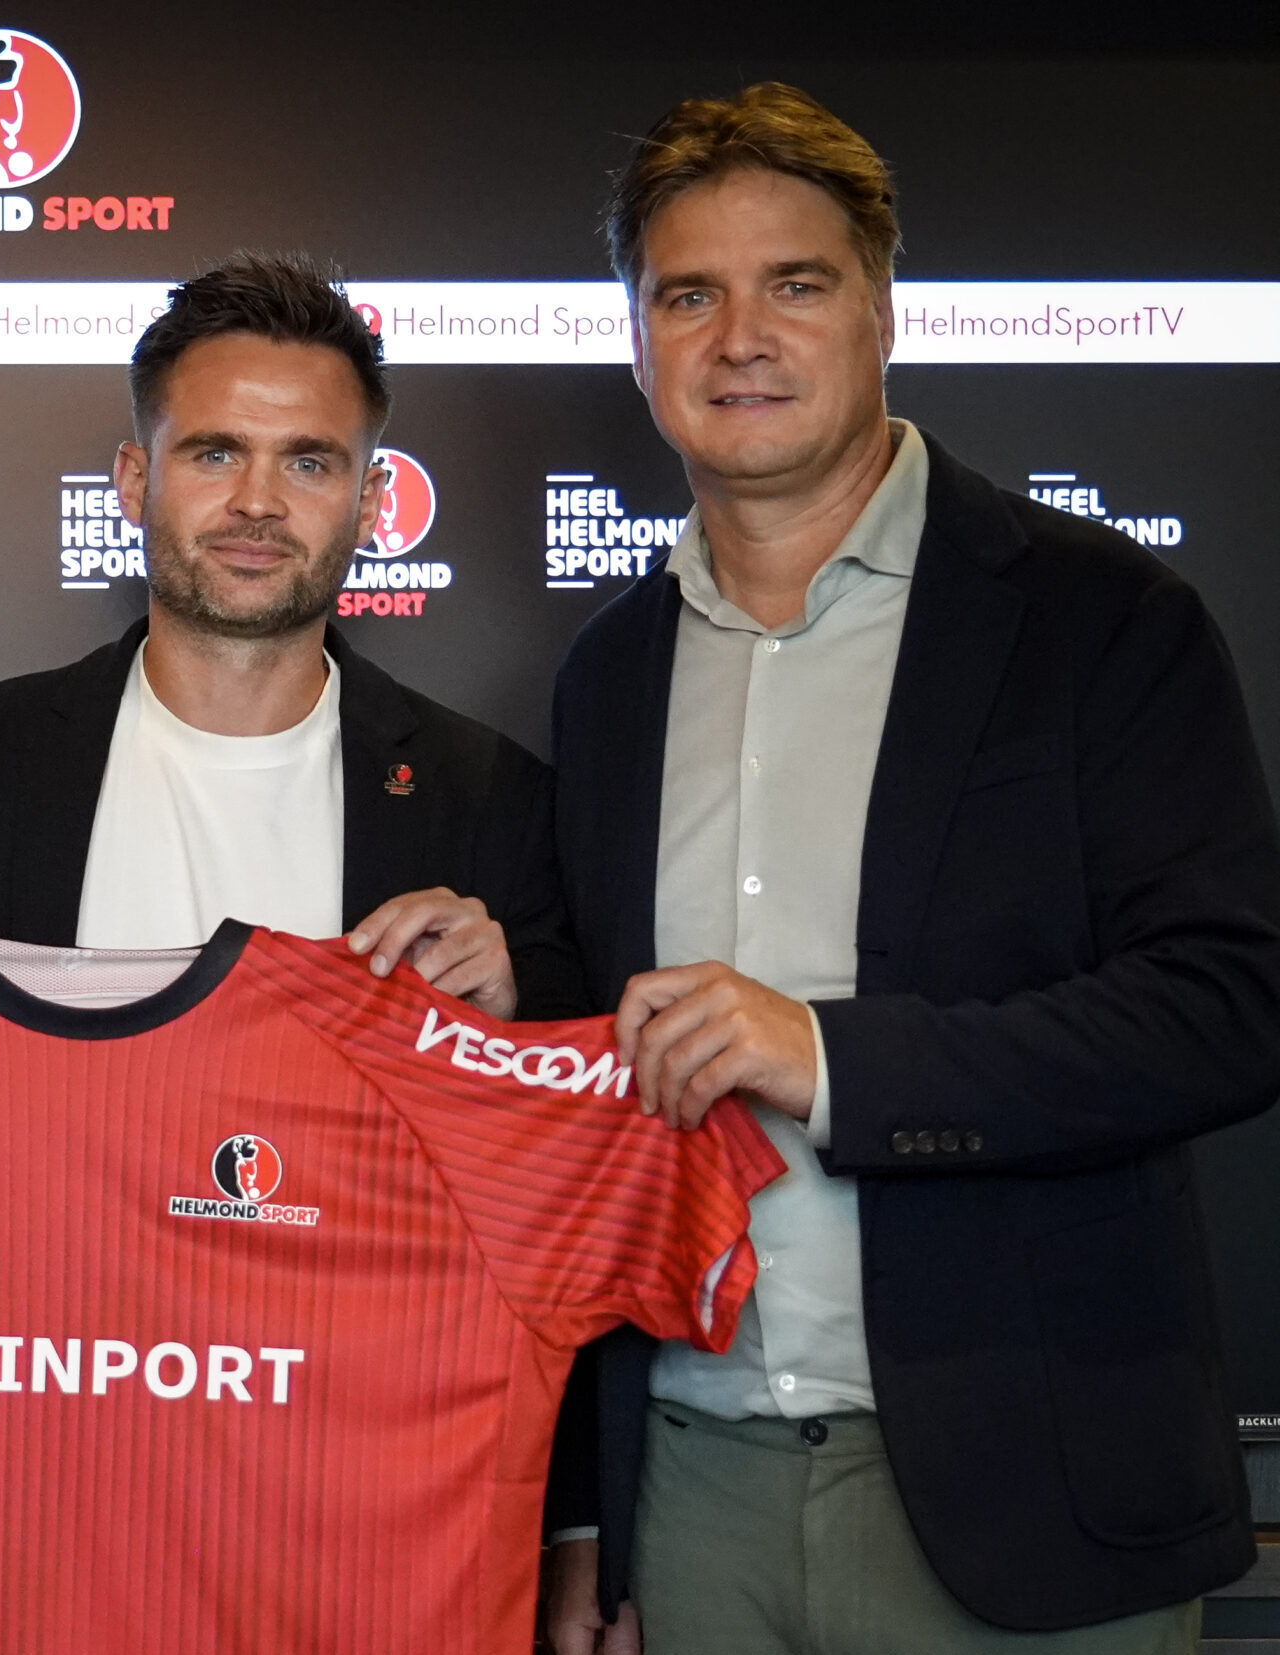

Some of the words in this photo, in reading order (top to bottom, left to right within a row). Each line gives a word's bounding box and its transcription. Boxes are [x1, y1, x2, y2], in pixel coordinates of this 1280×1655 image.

[43, 196, 175, 231] SPORT
[393, 304, 539, 336] Helmond
[552, 306, 629, 346] Spor
[905, 304, 1184, 346] HelmondSportTV
[61, 489, 123, 518] HEE
[546, 488, 624, 517] HEEL
[61, 519, 144, 548] HELM
[546, 518, 687, 547] HELMON
[60, 548, 148, 578] SPOR
[342, 562, 452, 589] LMOND
[545, 548, 652, 577] SPORT
[337, 591, 427, 617] SPORT
[415, 1007, 632, 1099] VESCOM
[170, 1198, 259, 1220] HELMOND
[261, 1205, 319, 1225] SPORT
[1238, 1417, 1280, 1426] BACKLI
